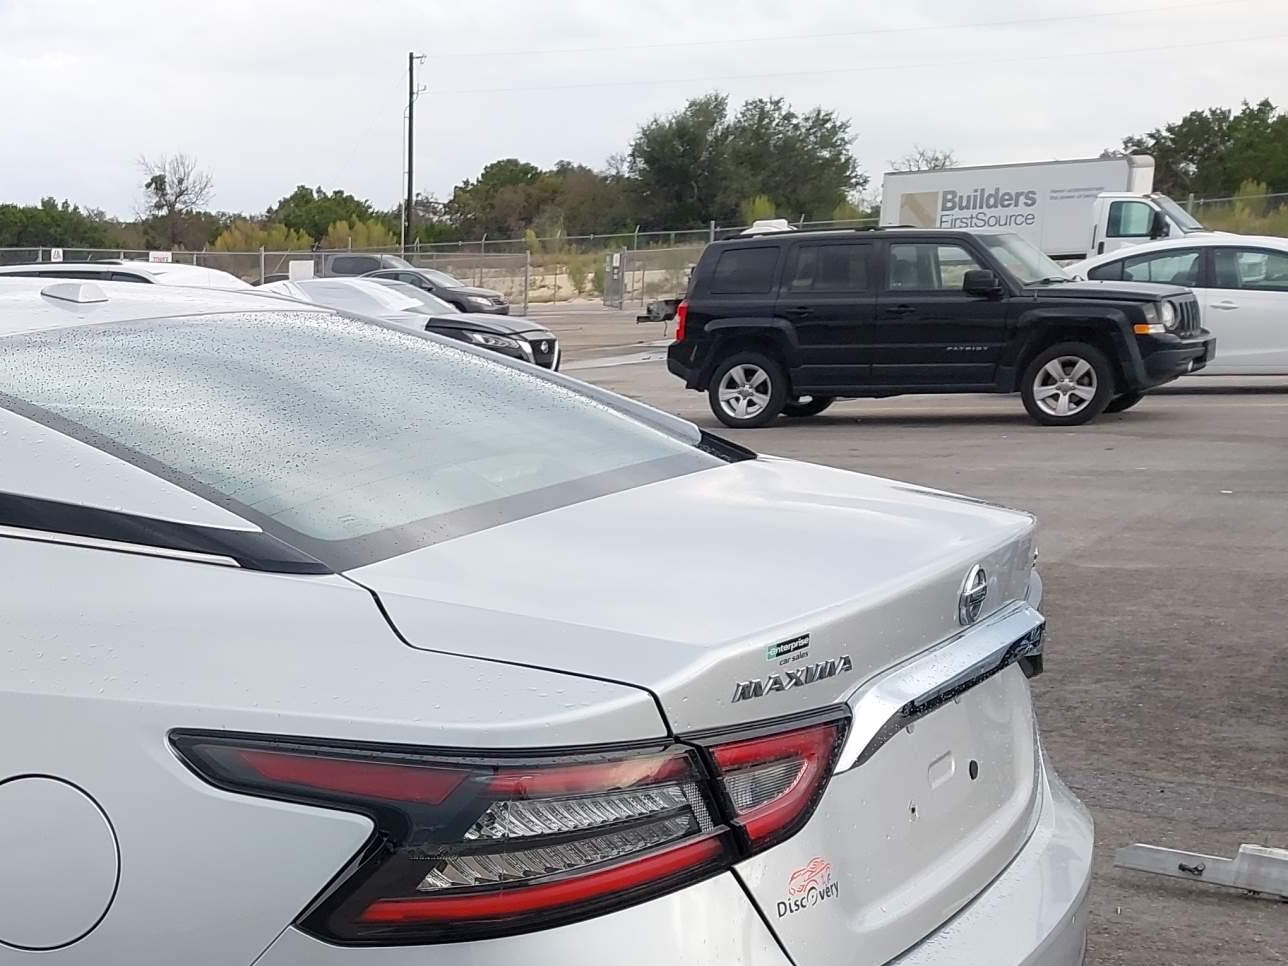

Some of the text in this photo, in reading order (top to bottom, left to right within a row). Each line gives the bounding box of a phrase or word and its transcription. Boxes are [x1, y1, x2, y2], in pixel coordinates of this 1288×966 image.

[941, 187, 1037, 211] Builders
[939, 211, 1036, 229] FirstSource
[768, 636, 809, 658] enterprise
[779, 650, 809, 666] car sales
[731, 655, 853, 703] MAXIMA
[776, 881, 839, 918] Discovery
